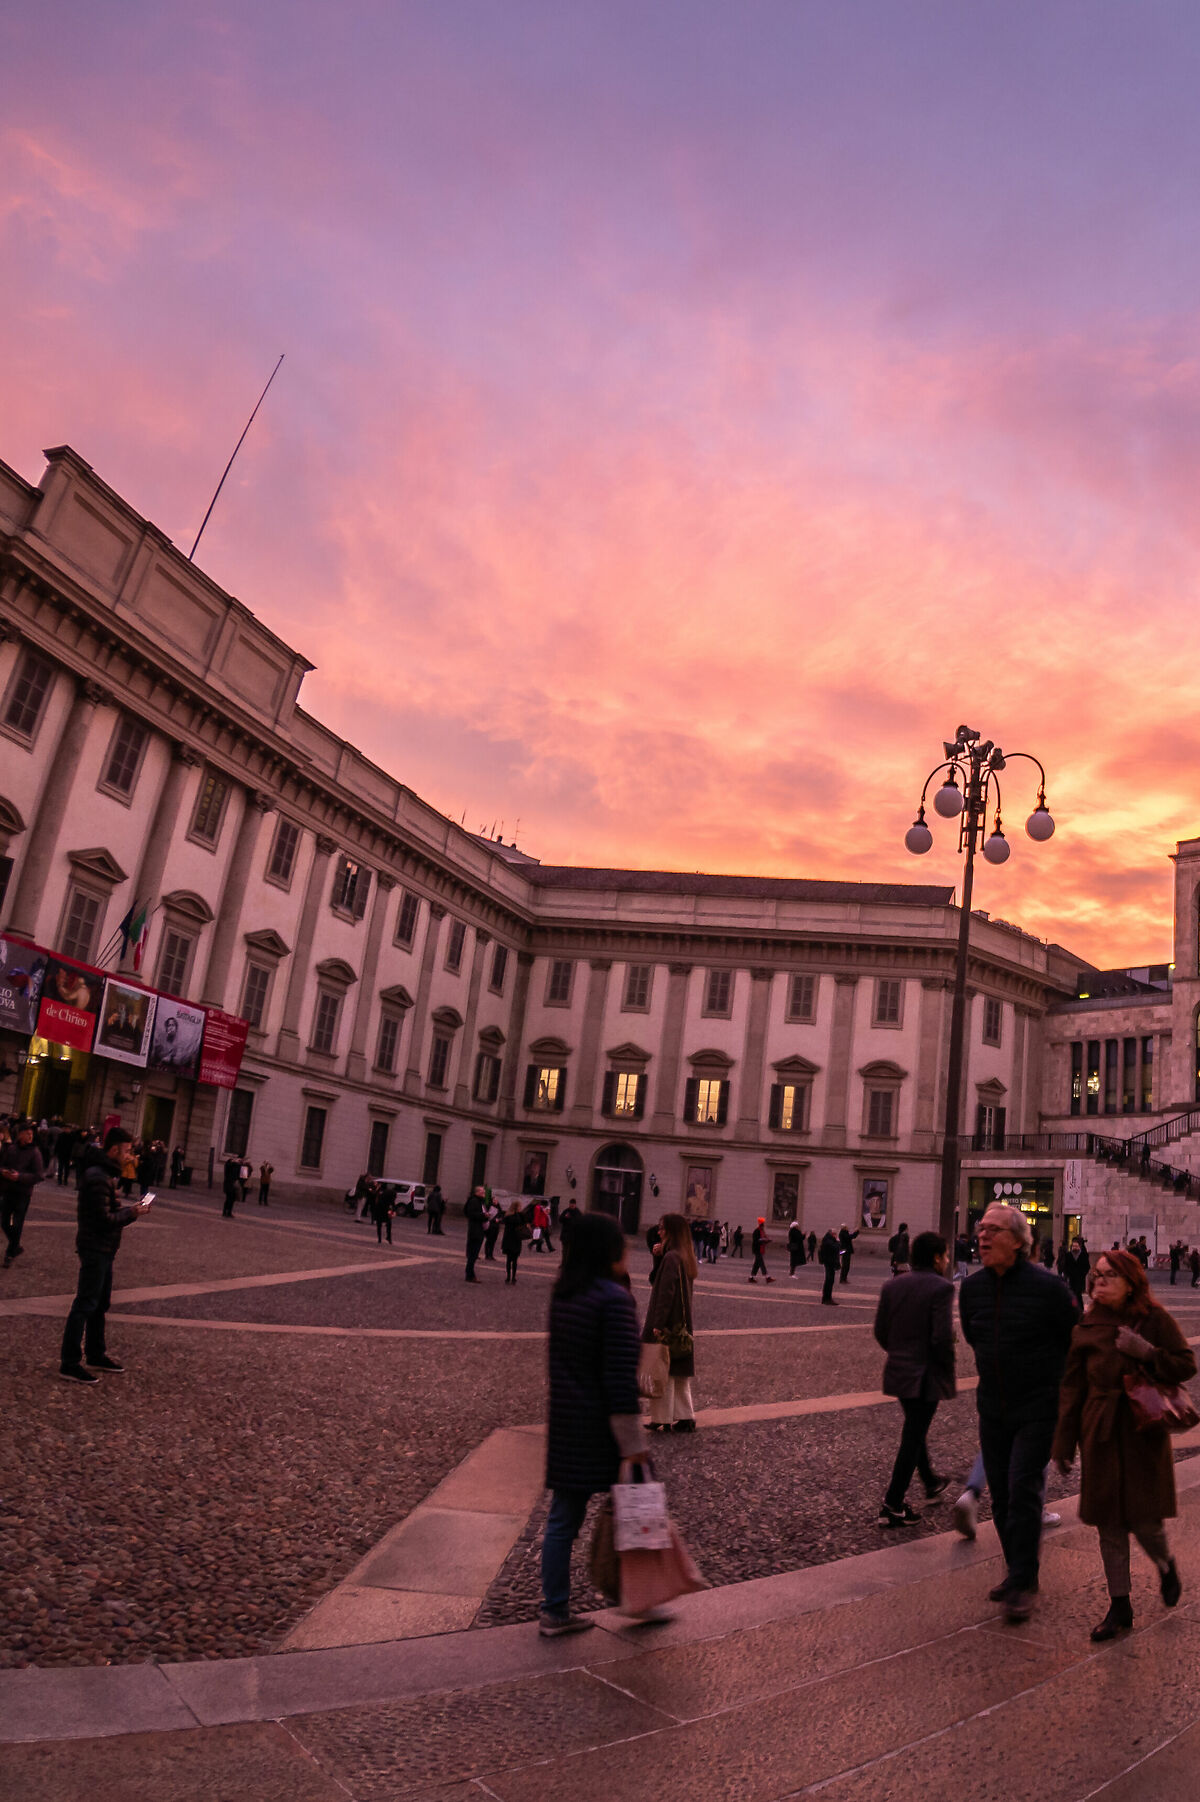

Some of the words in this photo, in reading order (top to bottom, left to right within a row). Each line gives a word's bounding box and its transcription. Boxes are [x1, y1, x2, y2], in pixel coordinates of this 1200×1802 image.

[46, 1004, 57, 1017] de
[58, 1009, 87, 1027] Chirico
[994, 1182, 1022, 1199] 900
